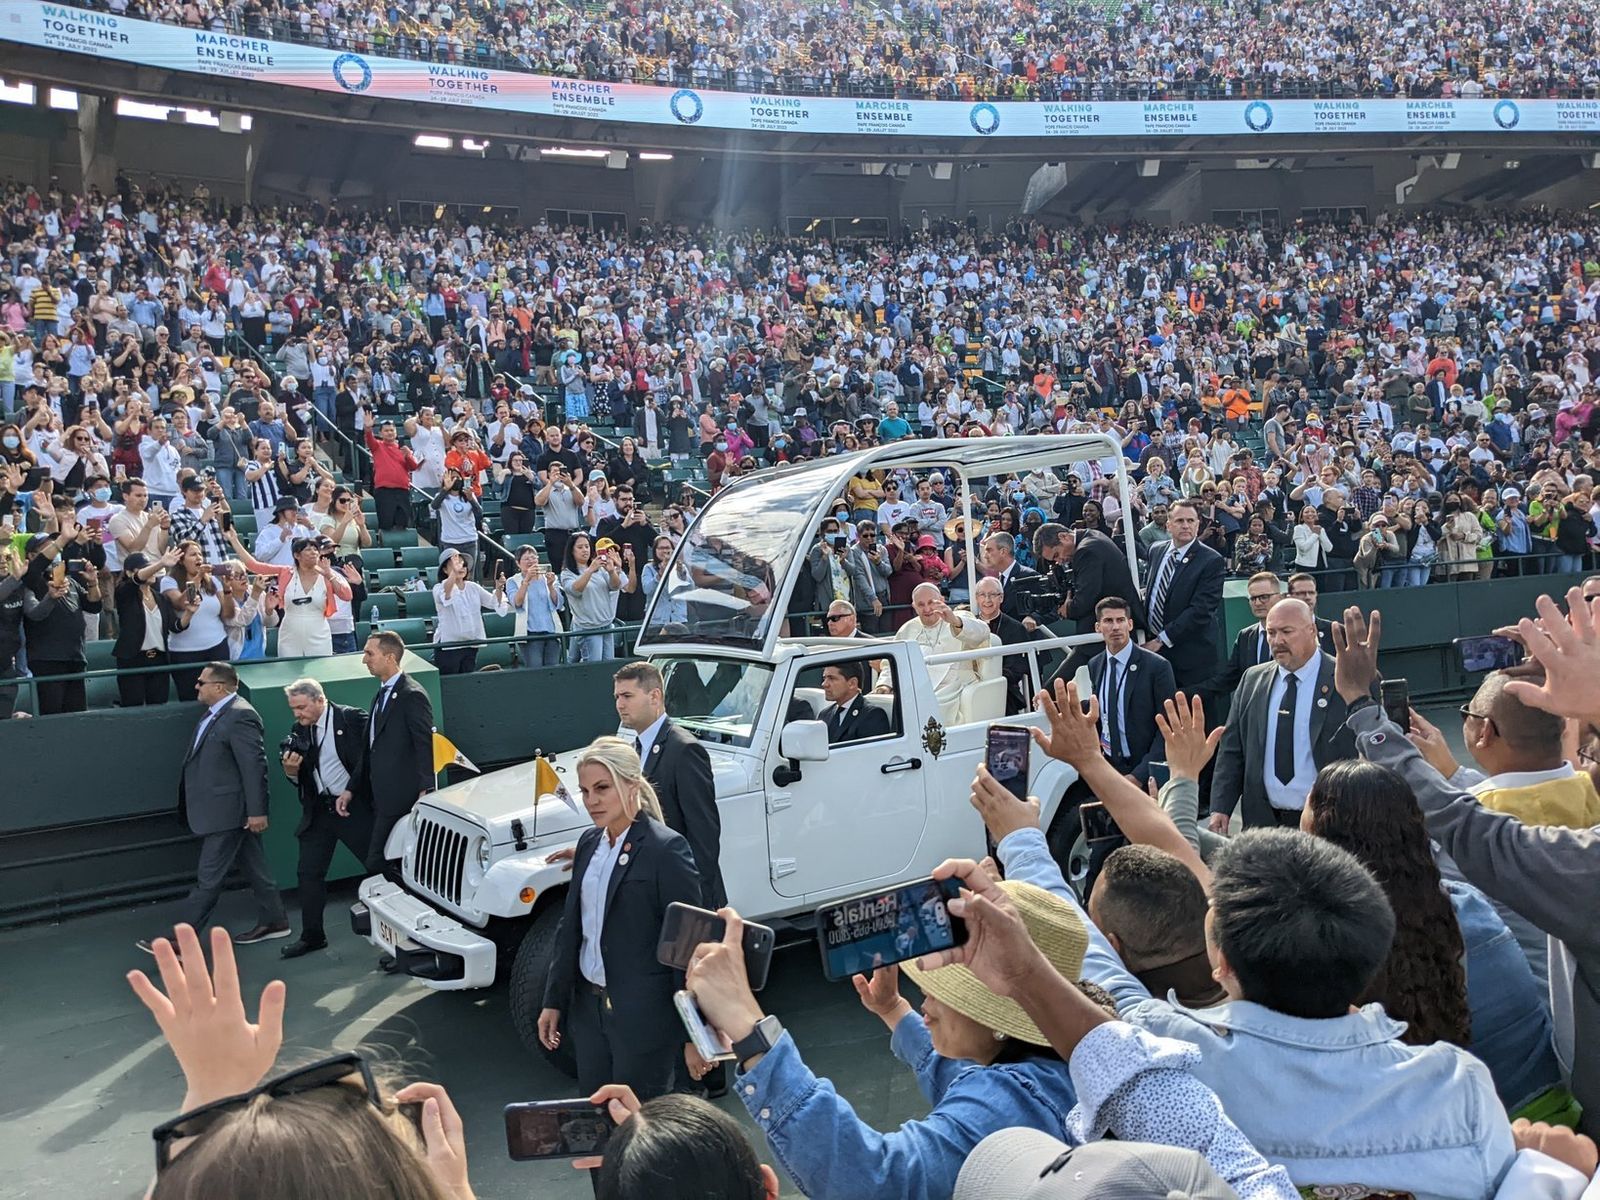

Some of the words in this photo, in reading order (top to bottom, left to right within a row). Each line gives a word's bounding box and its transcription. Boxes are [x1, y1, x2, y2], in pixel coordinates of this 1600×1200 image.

[42, 5, 118, 28] WALKING
[43, 19, 129, 44] TOGETHER
[195, 33, 269, 53] MARCHER
[197, 46, 274, 66] ENSEMBLE
[428, 66, 488, 81] WALKING
[429, 78, 498, 94] TOGETHER
[551, 80, 610, 94] MARCHER
[552, 91, 615, 106] ENSEMBLE
[749, 96, 801, 108] WALKING
[855, 101, 910, 111] MARCHER
[1043, 104, 1093, 113] WALKING
[1143, 103, 1194, 112] MARCHER
[1314, 102, 1359, 110] WALKING
[750, 107, 809, 119] TOGETHER
[856, 112, 913, 121] ENSEMBLE
[1044, 114, 1100, 123] TOGETHER
[1144, 113, 1198, 122] ENSEMBLE
[1314, 112, 1366, 120] TOGETHER
[1407, 111, 1456, 119] ENSEMBLE
[380, 920, 393, 945] SCV
